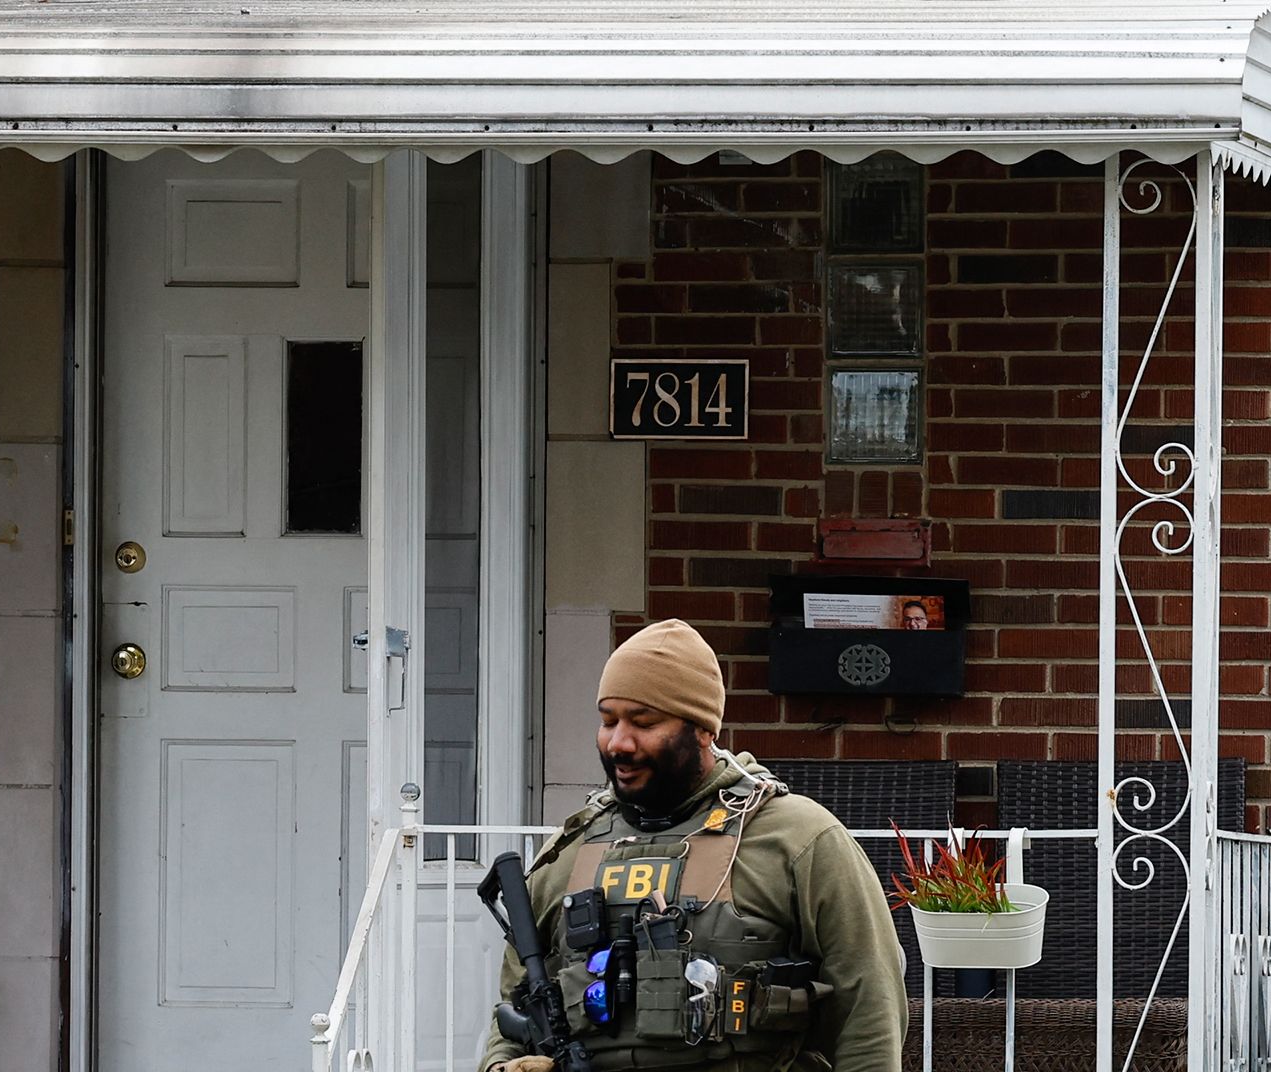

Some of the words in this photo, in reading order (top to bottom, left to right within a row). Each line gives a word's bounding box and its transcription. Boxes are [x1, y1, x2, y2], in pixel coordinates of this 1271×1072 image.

[626, 371, 733, 428] 7814
[601, 862, 671, 900] FBI
[732, 981, 745, 1031] FBI
